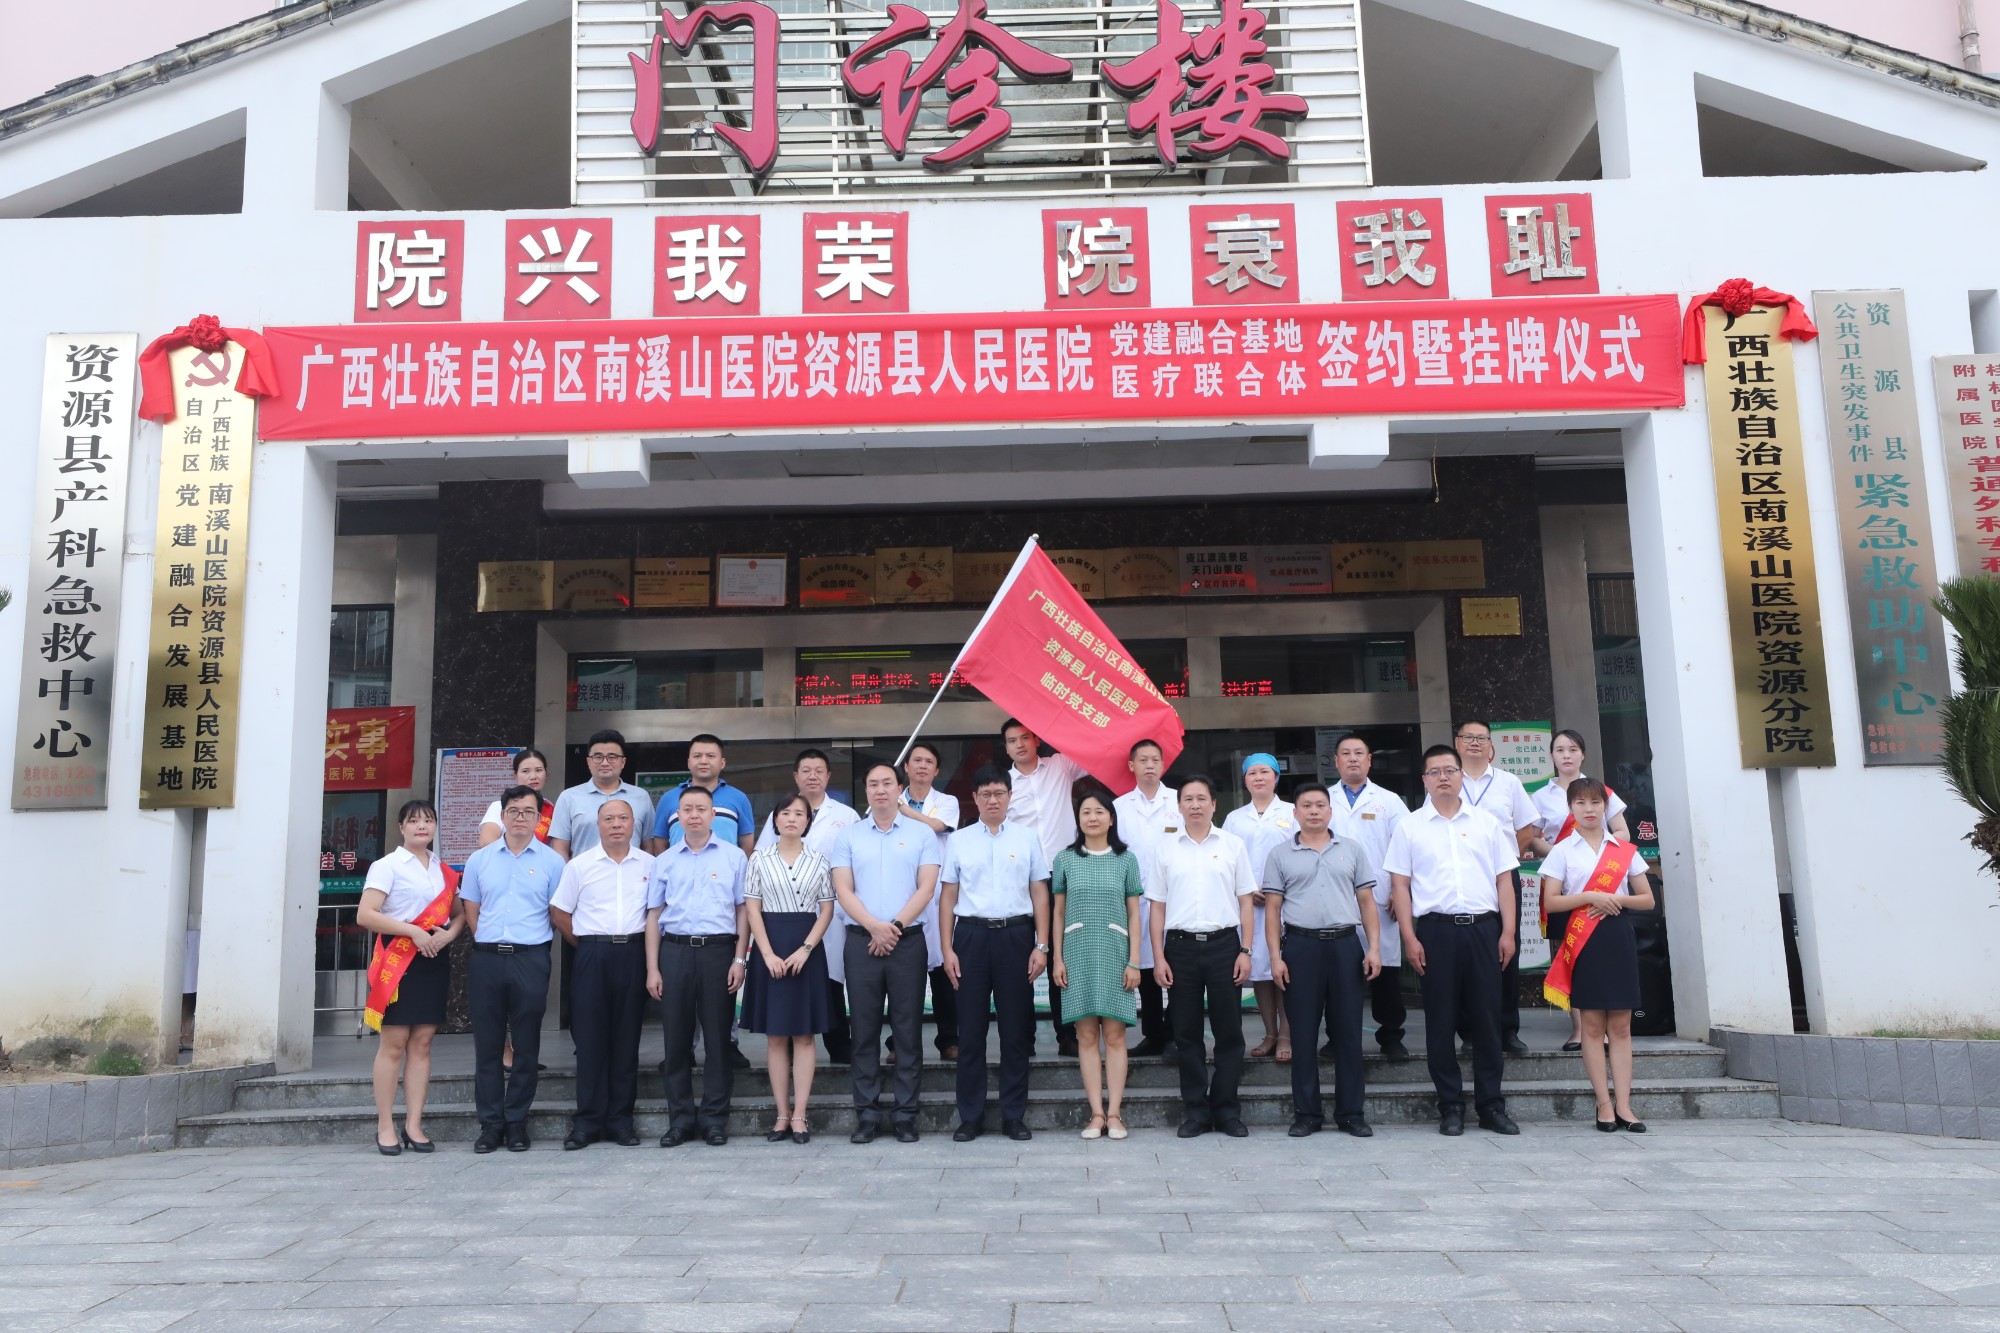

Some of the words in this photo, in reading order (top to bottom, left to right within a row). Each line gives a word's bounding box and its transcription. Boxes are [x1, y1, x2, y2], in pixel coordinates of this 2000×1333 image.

[628, 0, 1308, 177] 门诊楼
[366, 220, 896, 310] 院兴我荣
[1057, 203, 1587, 297] 院衰我耻
[296, 322, 1093, 412] 广西壮族自治区南溪山医院资源县人民医院
[1110, 317, 1303, 356] 党建融合基地
[1317, 314, 1644, 388] 签约暨挂牌仪式
[1111, 361, 1306, 399] 医疗联合体
[1833, 301, 1874, 463] 公共卫生突发事件
[1866, 301, 1909, 461] 资源县
[1953, 364, 1987, 450] 附属医院
[33, 343, 119, 759] 资源县产科急救中心
[1186, 552, 1248, 563] 资江漂流景区
[1192, 565, 1243, 575] 天门山景区
[1413, 554, 1479, 565] 资源县文明单位
[1722, 308, 1815, 754] 广西壮族自治区南溪山医院资源分院
[1854, 473, 1937, 716] 紧急救助中心
[157, 482, 201, 792] 党建融合发展基地
[191, 482, 233, 791] 南溪山医院资源县人民医院
[1040, 671, 1111, 728] 临时党支部
[1043, 637, 1140, 716] 资源县人民医院
[364, 766, 377, 780] 宣
[1501, 734, 1542, 743] 温馨提示
[1515, 745, 1545, 753] 您已进入
[1637, 821, 1658, 840] 急
